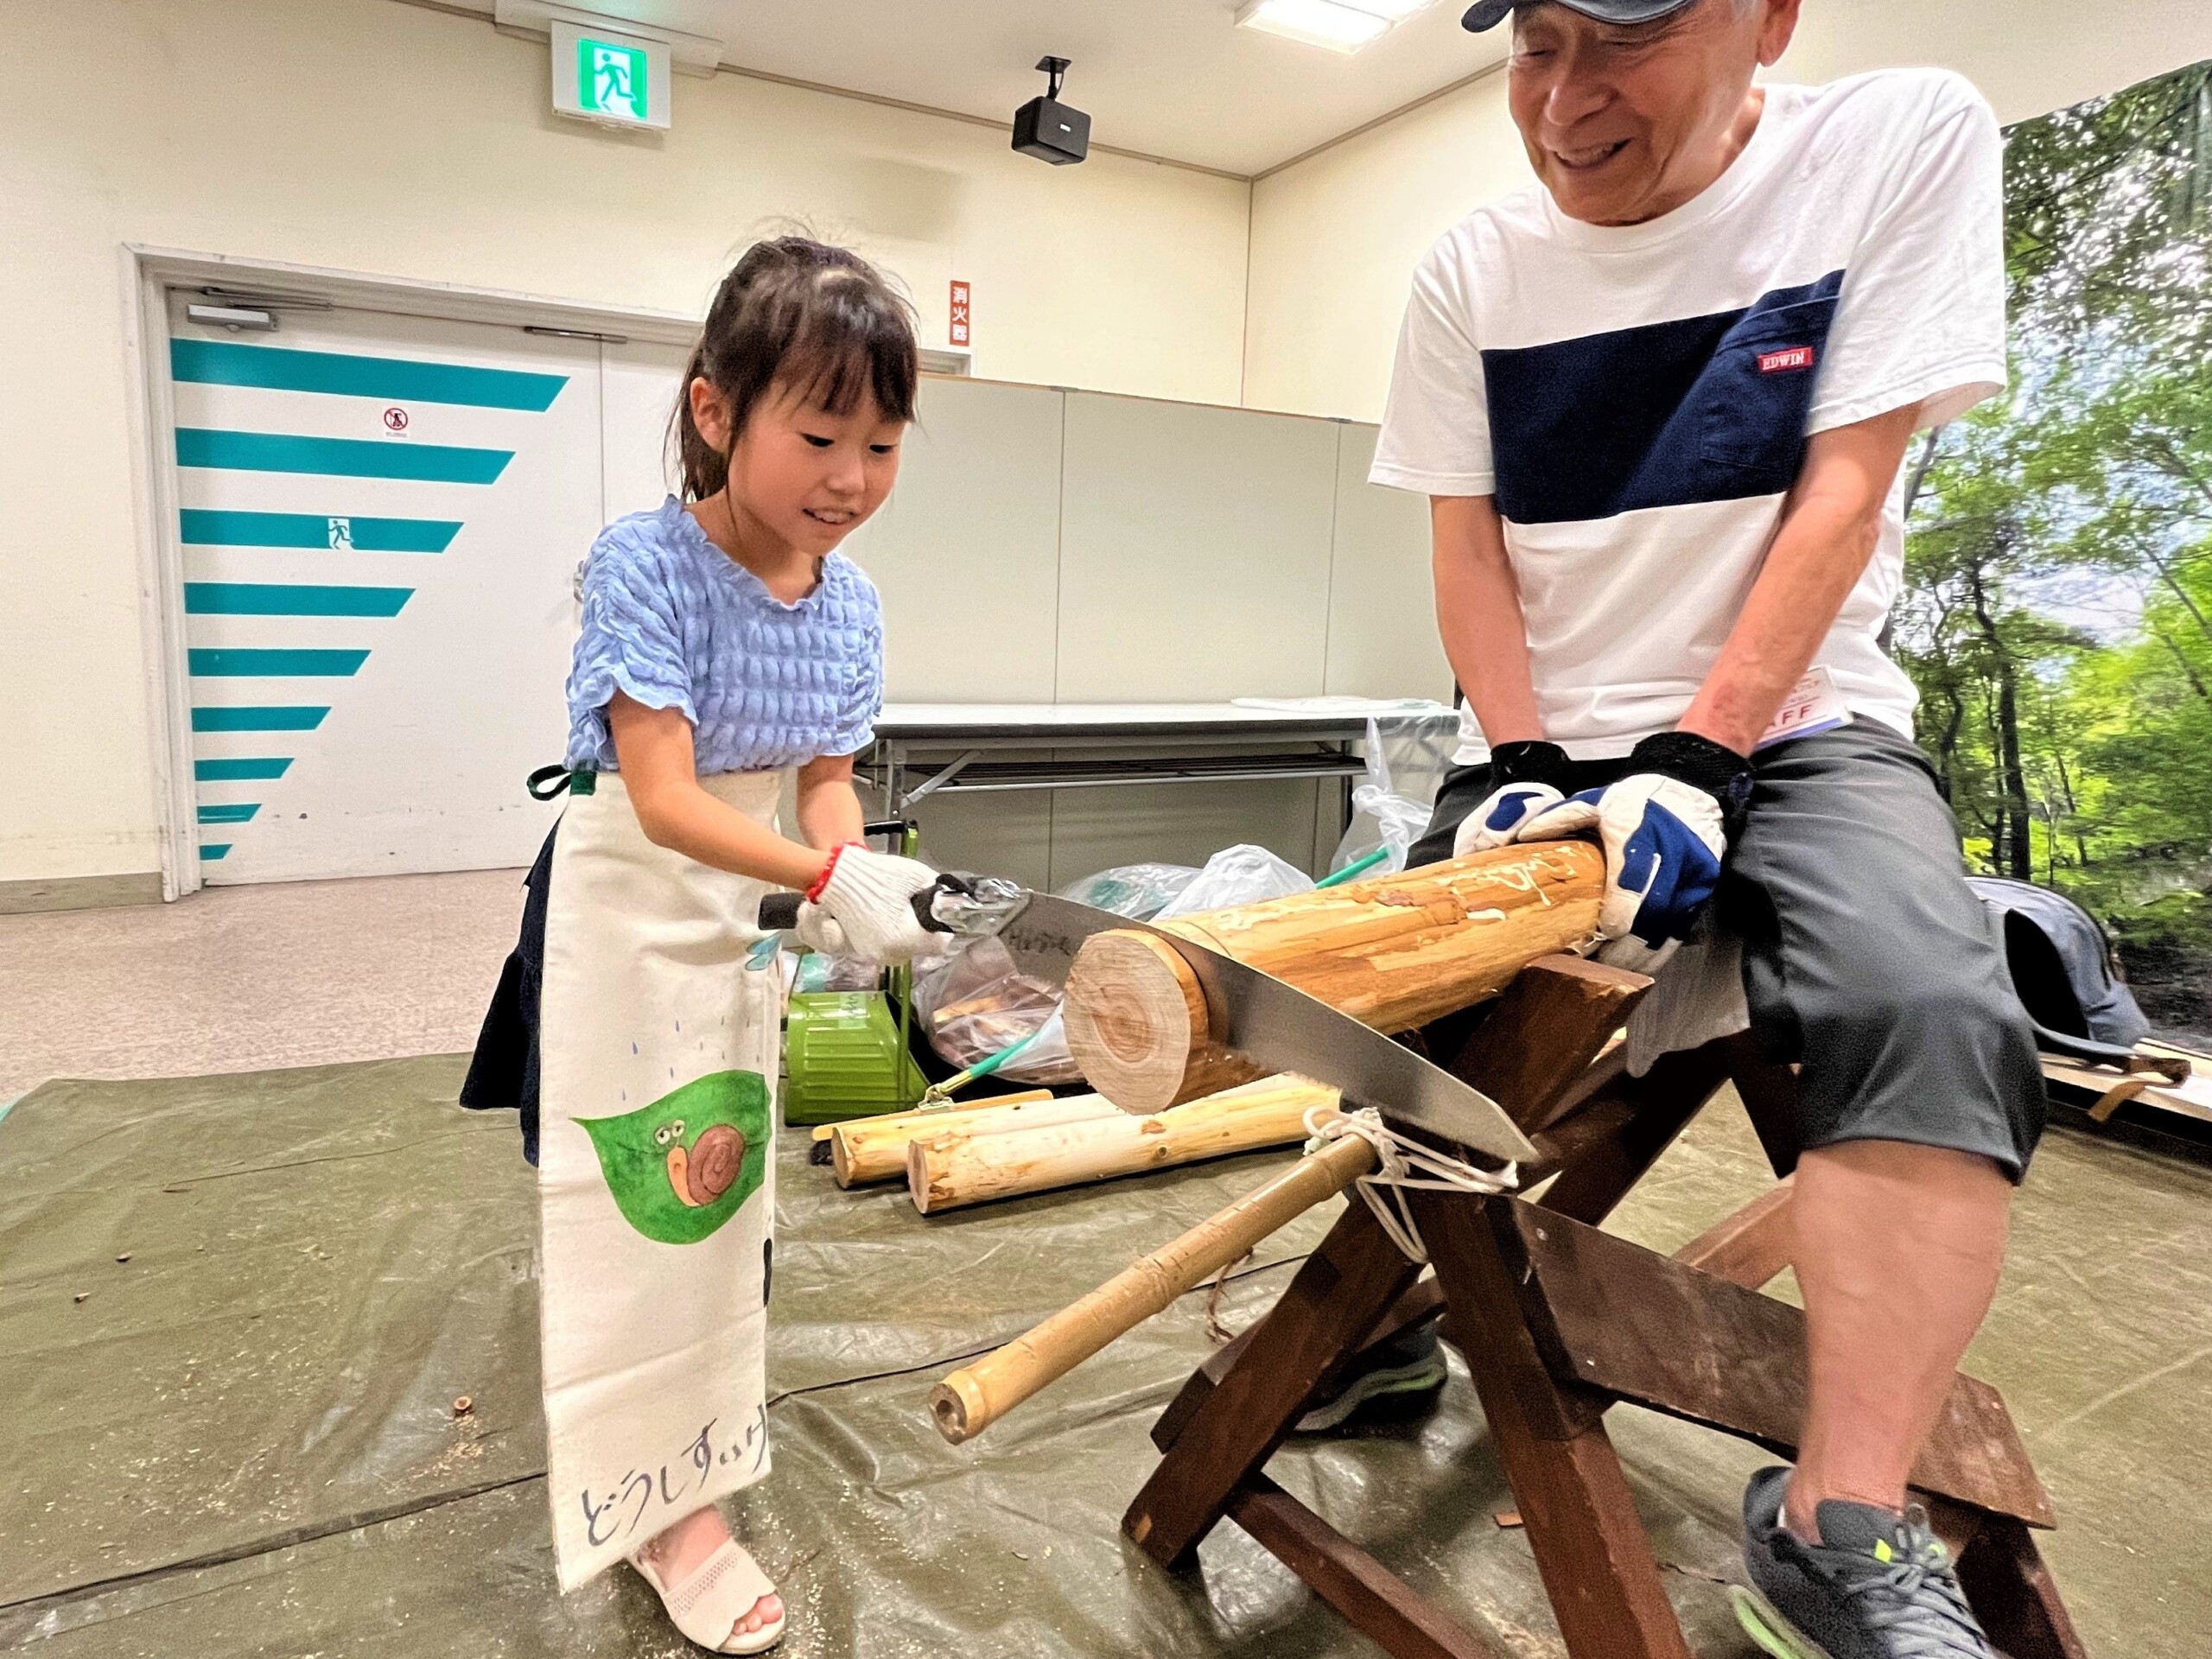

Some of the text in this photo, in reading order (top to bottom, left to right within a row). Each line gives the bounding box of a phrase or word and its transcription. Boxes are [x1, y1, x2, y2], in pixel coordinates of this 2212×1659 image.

[952, 287, 968, 341] 消火器
[1763, 351, 1805, 371] EDWIN
[1771, 704, 1812, 727] FF
